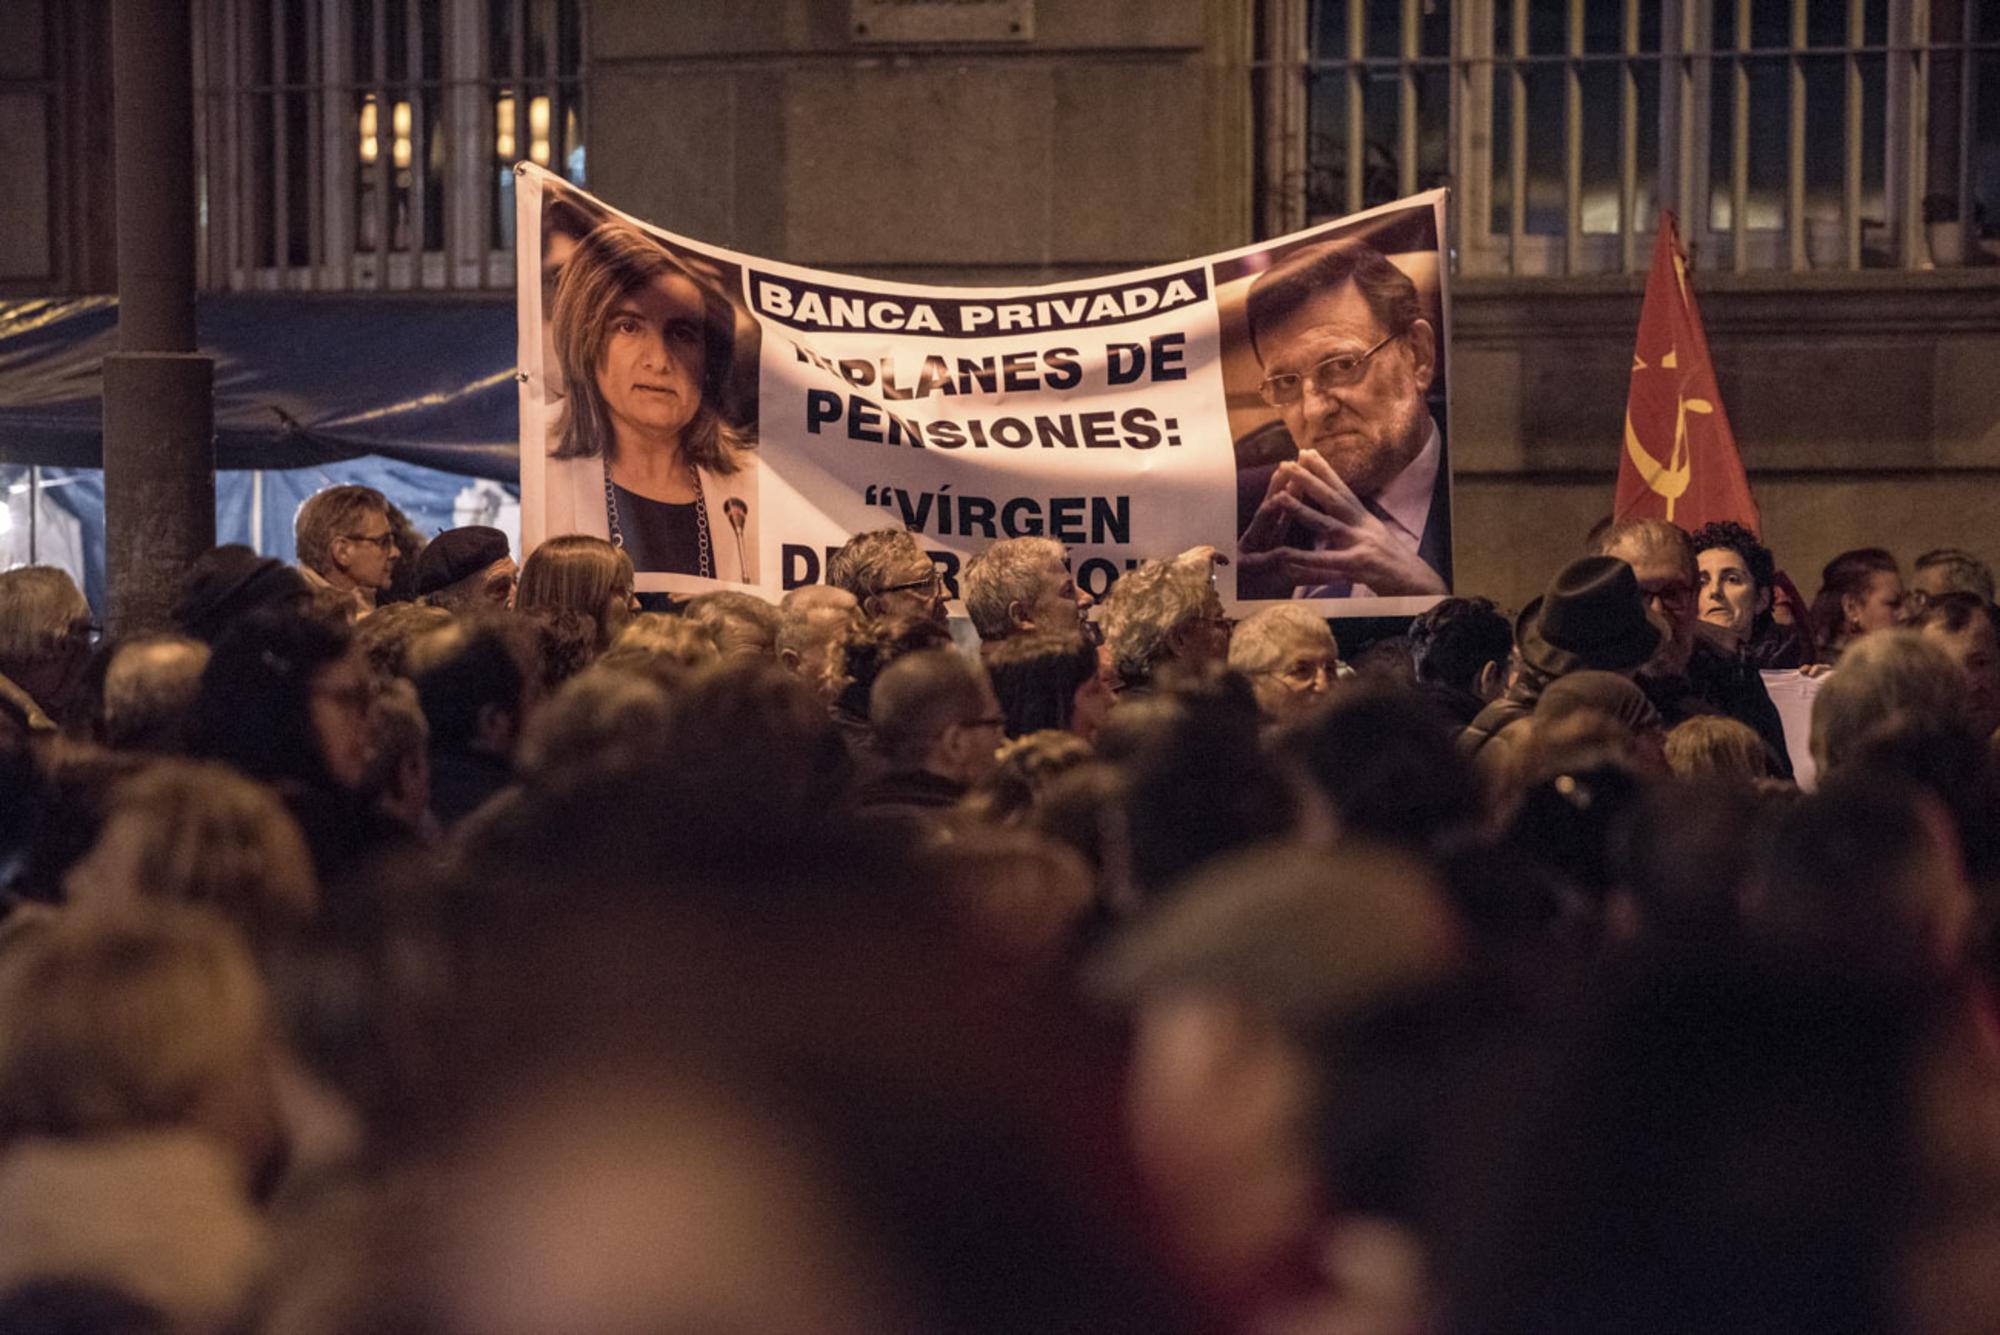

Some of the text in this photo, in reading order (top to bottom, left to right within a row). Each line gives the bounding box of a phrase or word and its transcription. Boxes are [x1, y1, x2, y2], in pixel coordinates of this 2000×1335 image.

[759, 279, 1197, 331] BANCA PRIVADA
[1106, 332, 1187, 386] DE
[807, 388, 1182, 450] PENSIONES:
